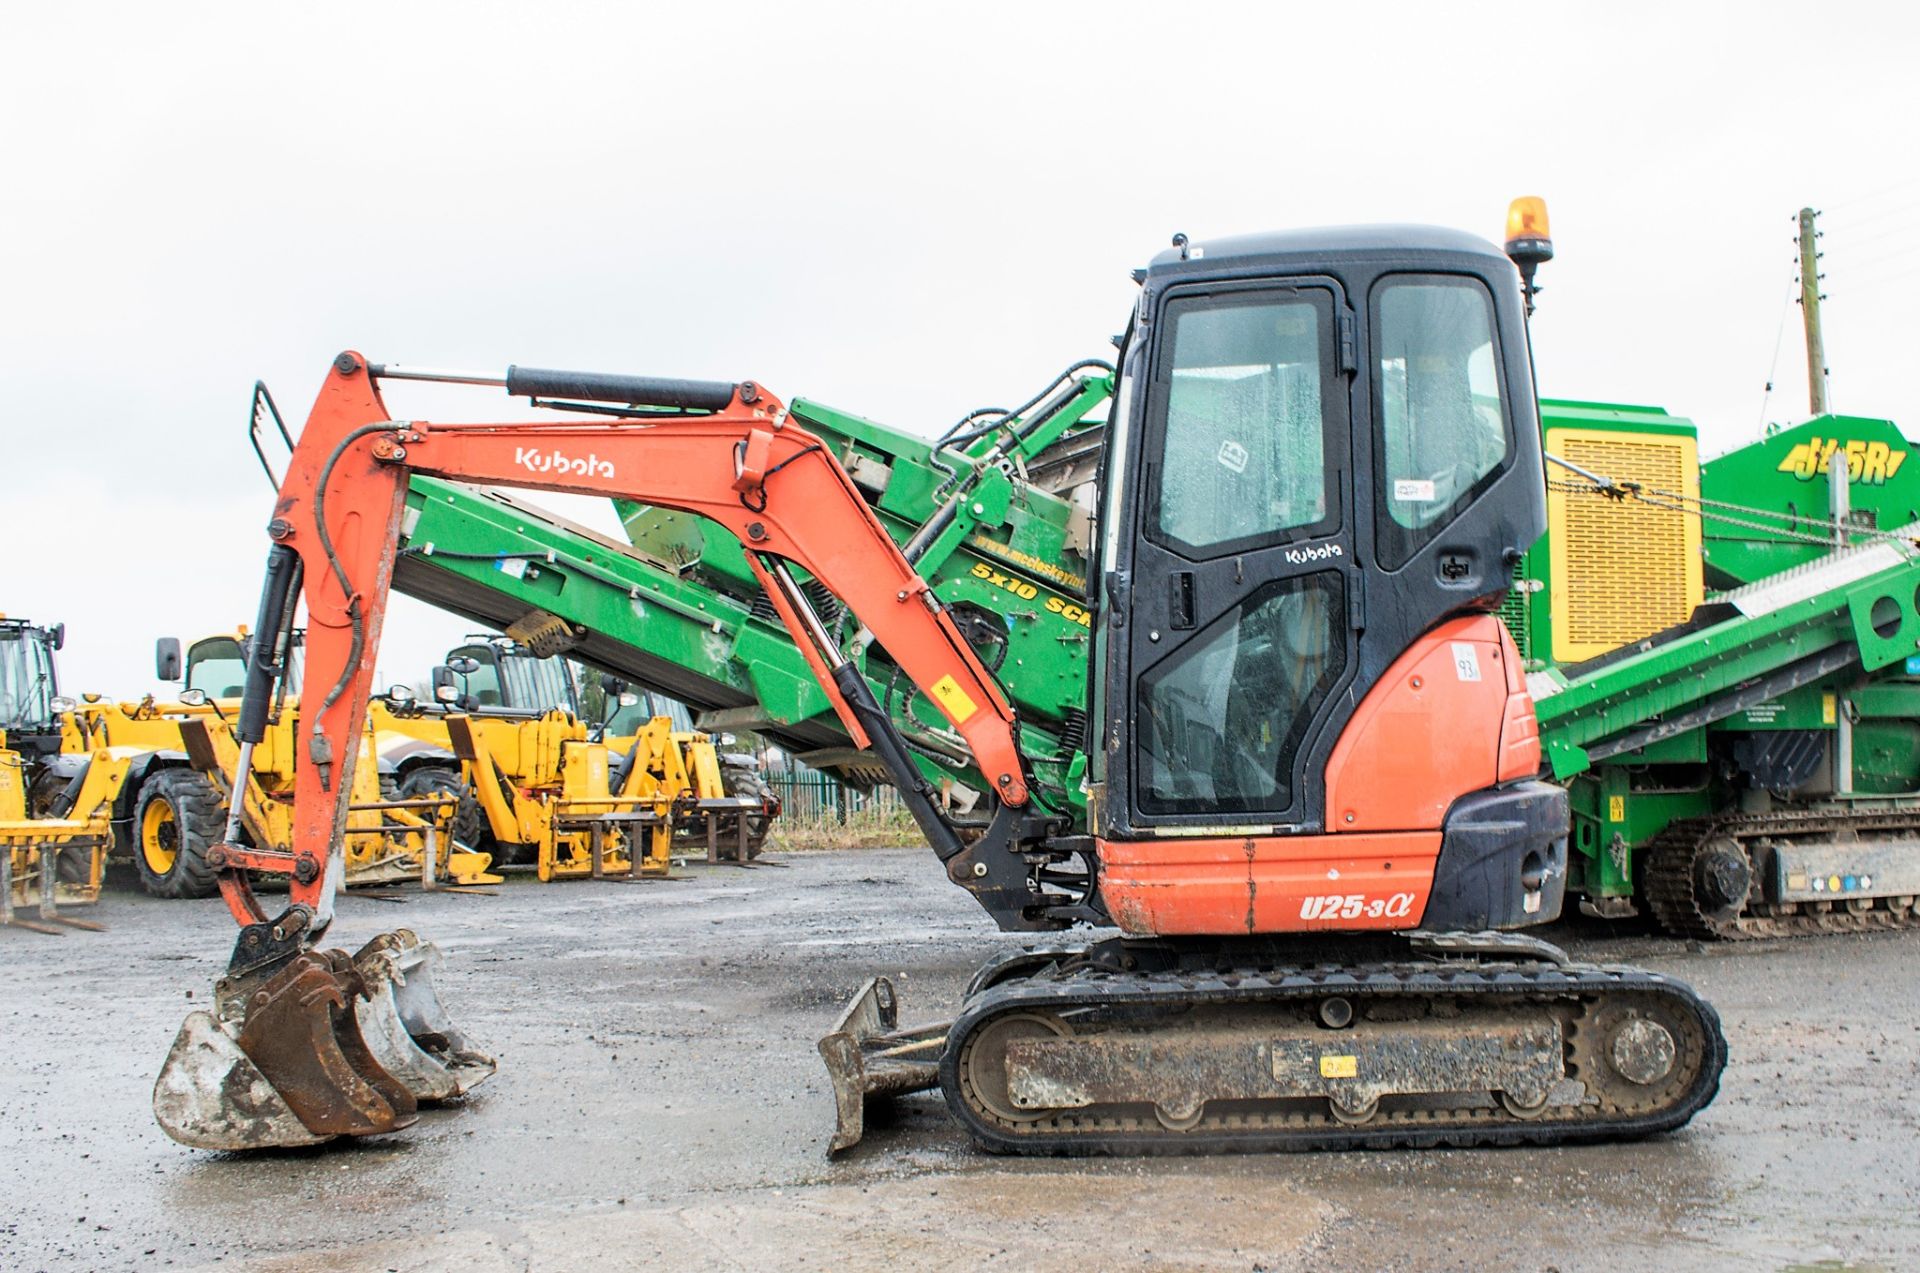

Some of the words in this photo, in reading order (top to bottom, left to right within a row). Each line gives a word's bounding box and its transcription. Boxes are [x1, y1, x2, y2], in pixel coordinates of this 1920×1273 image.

[515, 447, 615, 478] Kubota
[1285, 543, 1343, 564] Kubota
[971, 562, 1039, 600] 5x10
